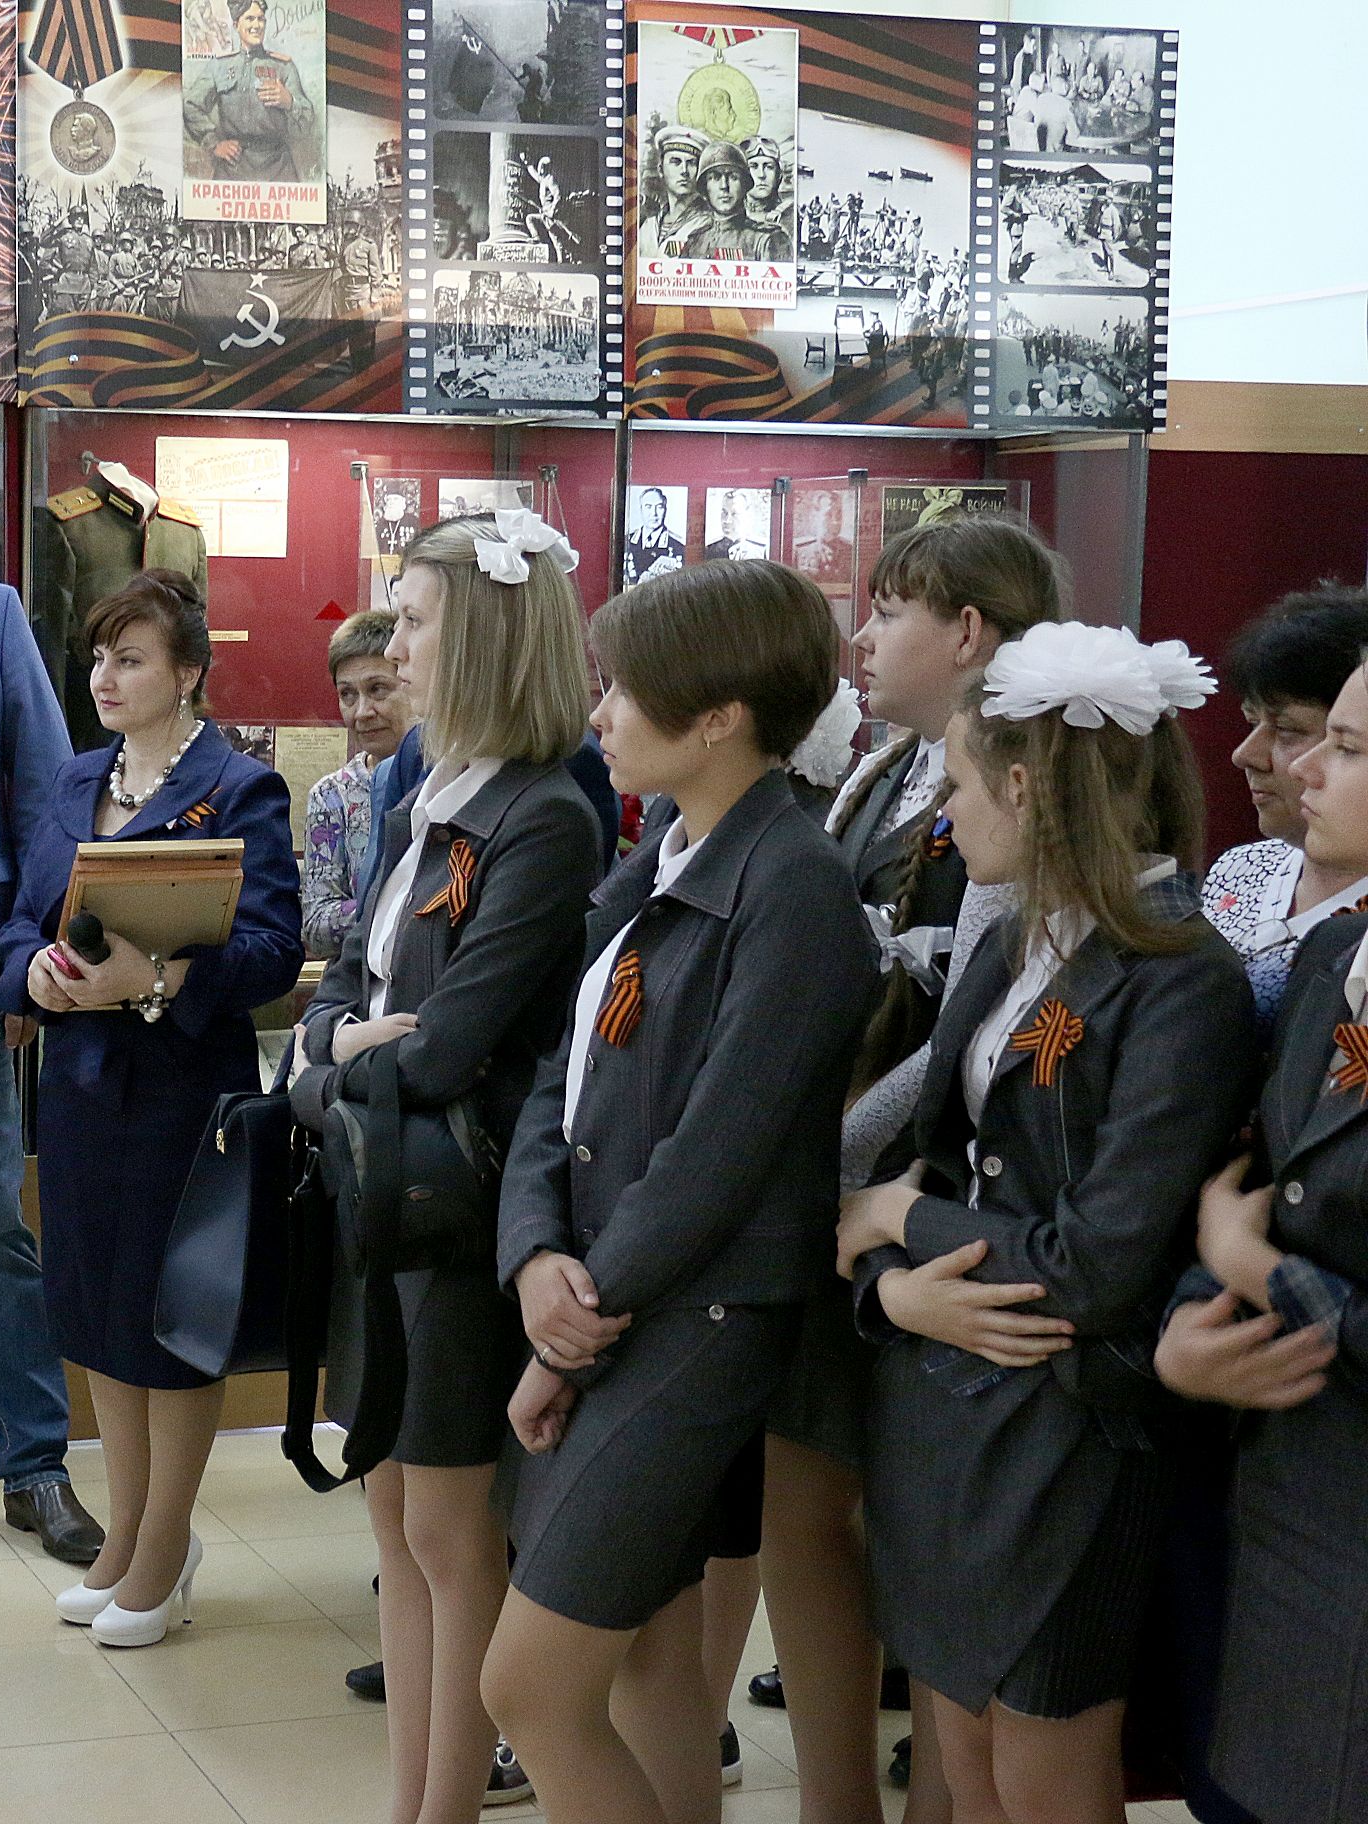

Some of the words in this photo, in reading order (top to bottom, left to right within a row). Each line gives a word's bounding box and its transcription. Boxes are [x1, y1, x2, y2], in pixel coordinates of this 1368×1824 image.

[192, 183, 261, 200] КРАСНОЙ
[268, 186, 319, 202] АРМИИ
[648, 262, 782, 278] СЛАВА
[639, 276, 721, 289] ВООРУЖЕННЫМ
[724, 279, 759, 290] СИЛАМ
[638, 289, 696, 298] ОДЕРЖАВШИМ
[698, 290, 729, 299] ПОБЕДУ
